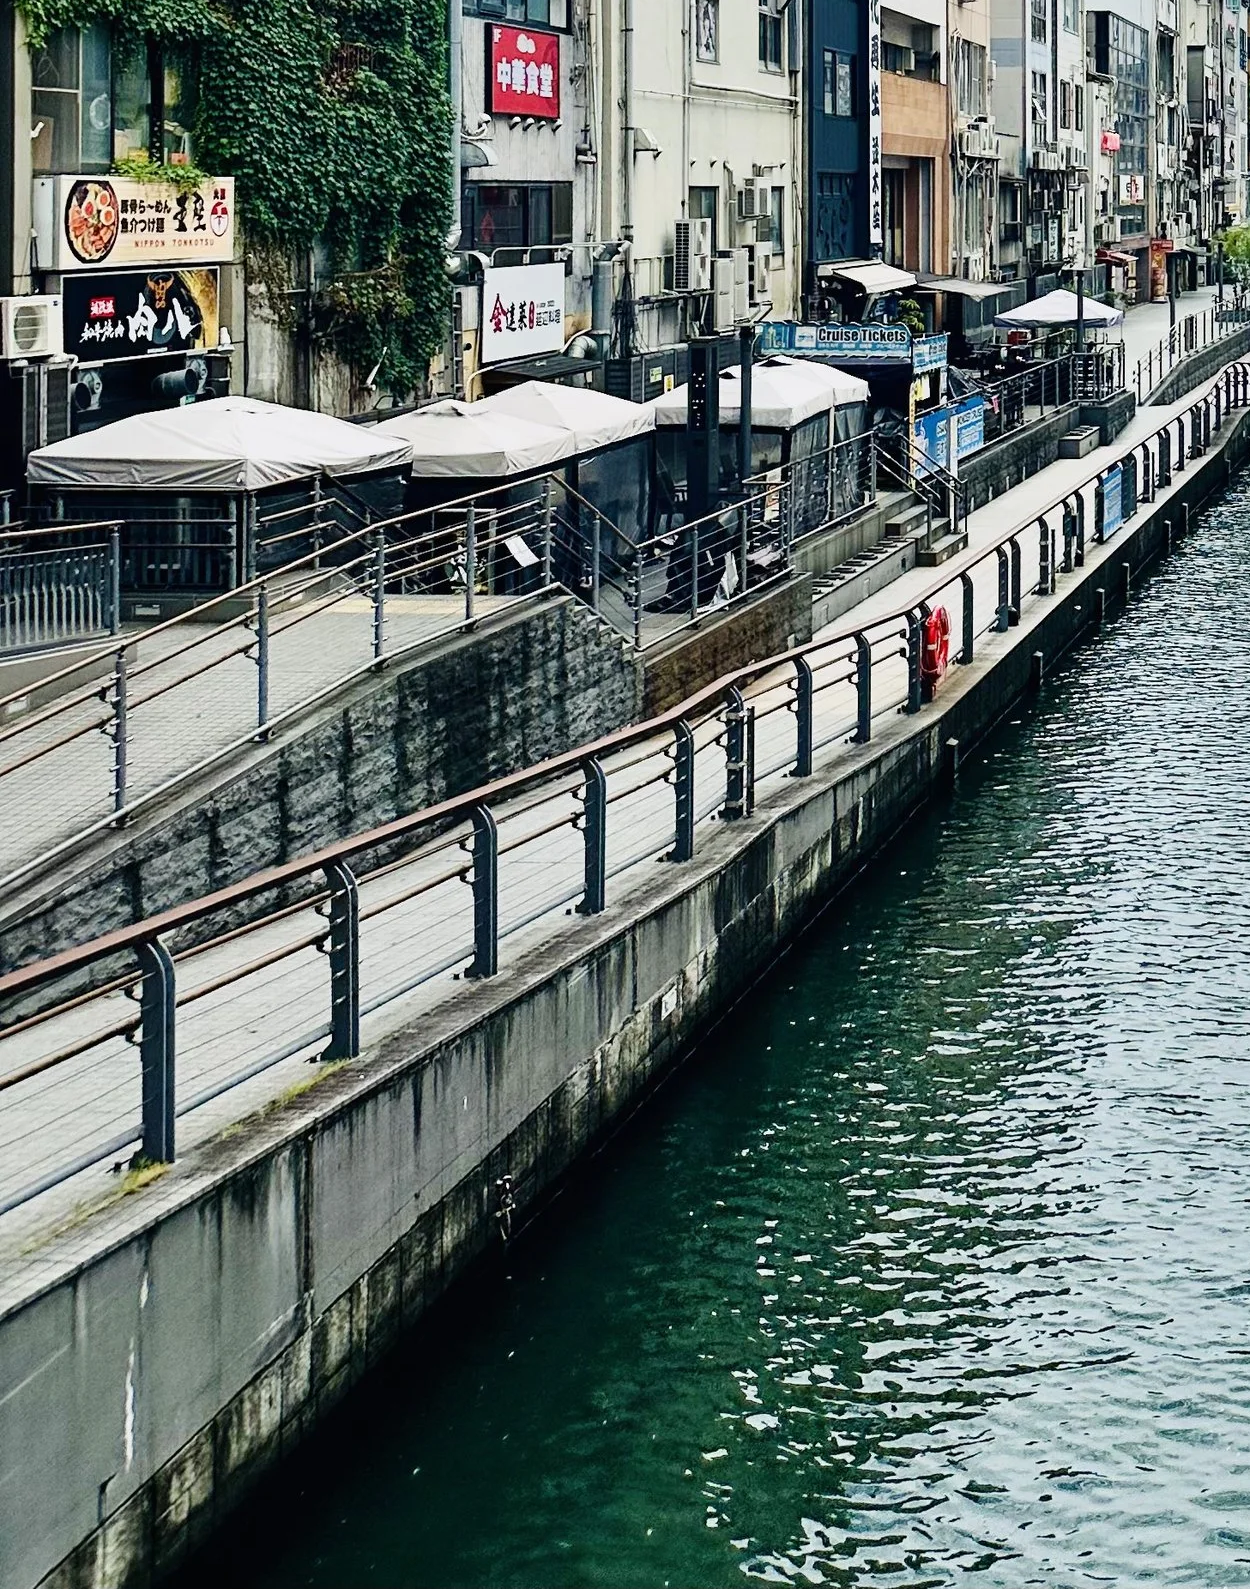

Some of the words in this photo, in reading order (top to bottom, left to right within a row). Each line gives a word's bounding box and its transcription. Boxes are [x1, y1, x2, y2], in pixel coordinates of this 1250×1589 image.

[135, 239, 165, 248] NIPPON
[173, 237, 215, 247] TONKOTSU
[818, 327, 859, 343] Cruise
[861, 328, 907, 343] Tickets
